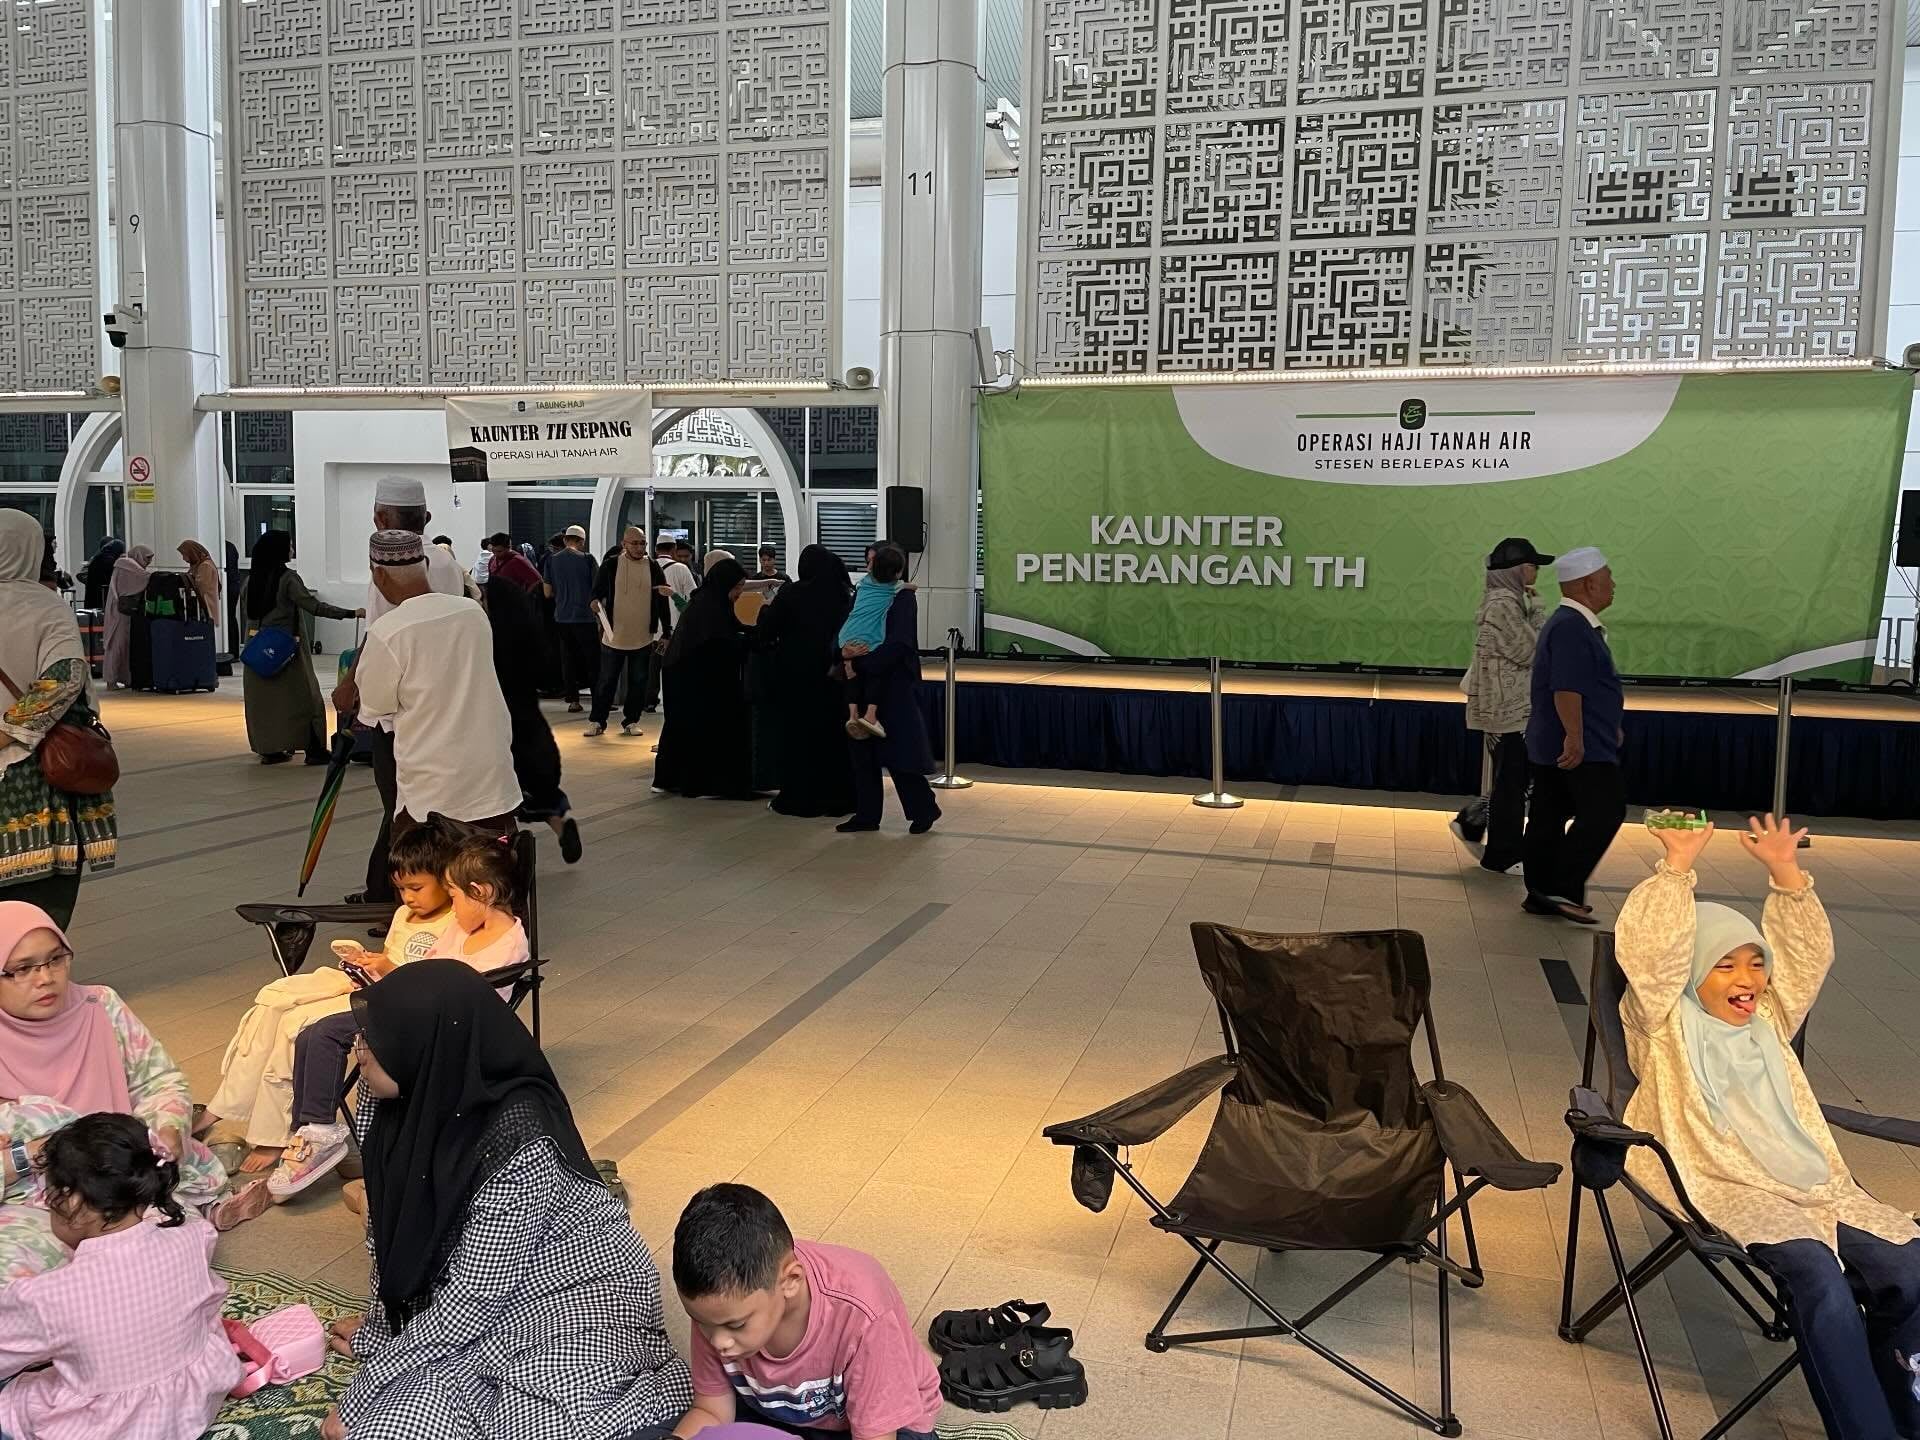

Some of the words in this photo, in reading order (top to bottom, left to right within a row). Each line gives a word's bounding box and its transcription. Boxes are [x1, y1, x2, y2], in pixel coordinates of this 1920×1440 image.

[908, 171, 932, 196] 11
[129, 214, 140, 234] 9
[535, 400, 566, 410] TABUNG
[567, 399, 585, 409] HAJI
[470, 424, 540, 443] KAUNTER
[546, 422, 568, 440] TH
[571, 420, 632, 439] SEPANG
[1297, 433, 1372, 452] OPERASI
[1381, 432, 1421, 451] HAJI
[1430, 431, 1490, 450] TANAH
[1499, 431, 1531, 450] AIR
[489, 450, 534, 460] OPERASI
[536, 449, 559, 459] HAJI
[560, 448, 597, 458] TANAH
[599, 447, 618, 457] AIR
[1314, 459, 1374, 470] STESEN
[1381, 458, 1465, 469] BERLEPAS
[1472, 458, 1510, 469] KLIA
[1090, 514, 1284, 547] KAUNTER
[1016, 552, 1292, 587] PENERANGAN
[1305, 556, 1366, 588] TH
